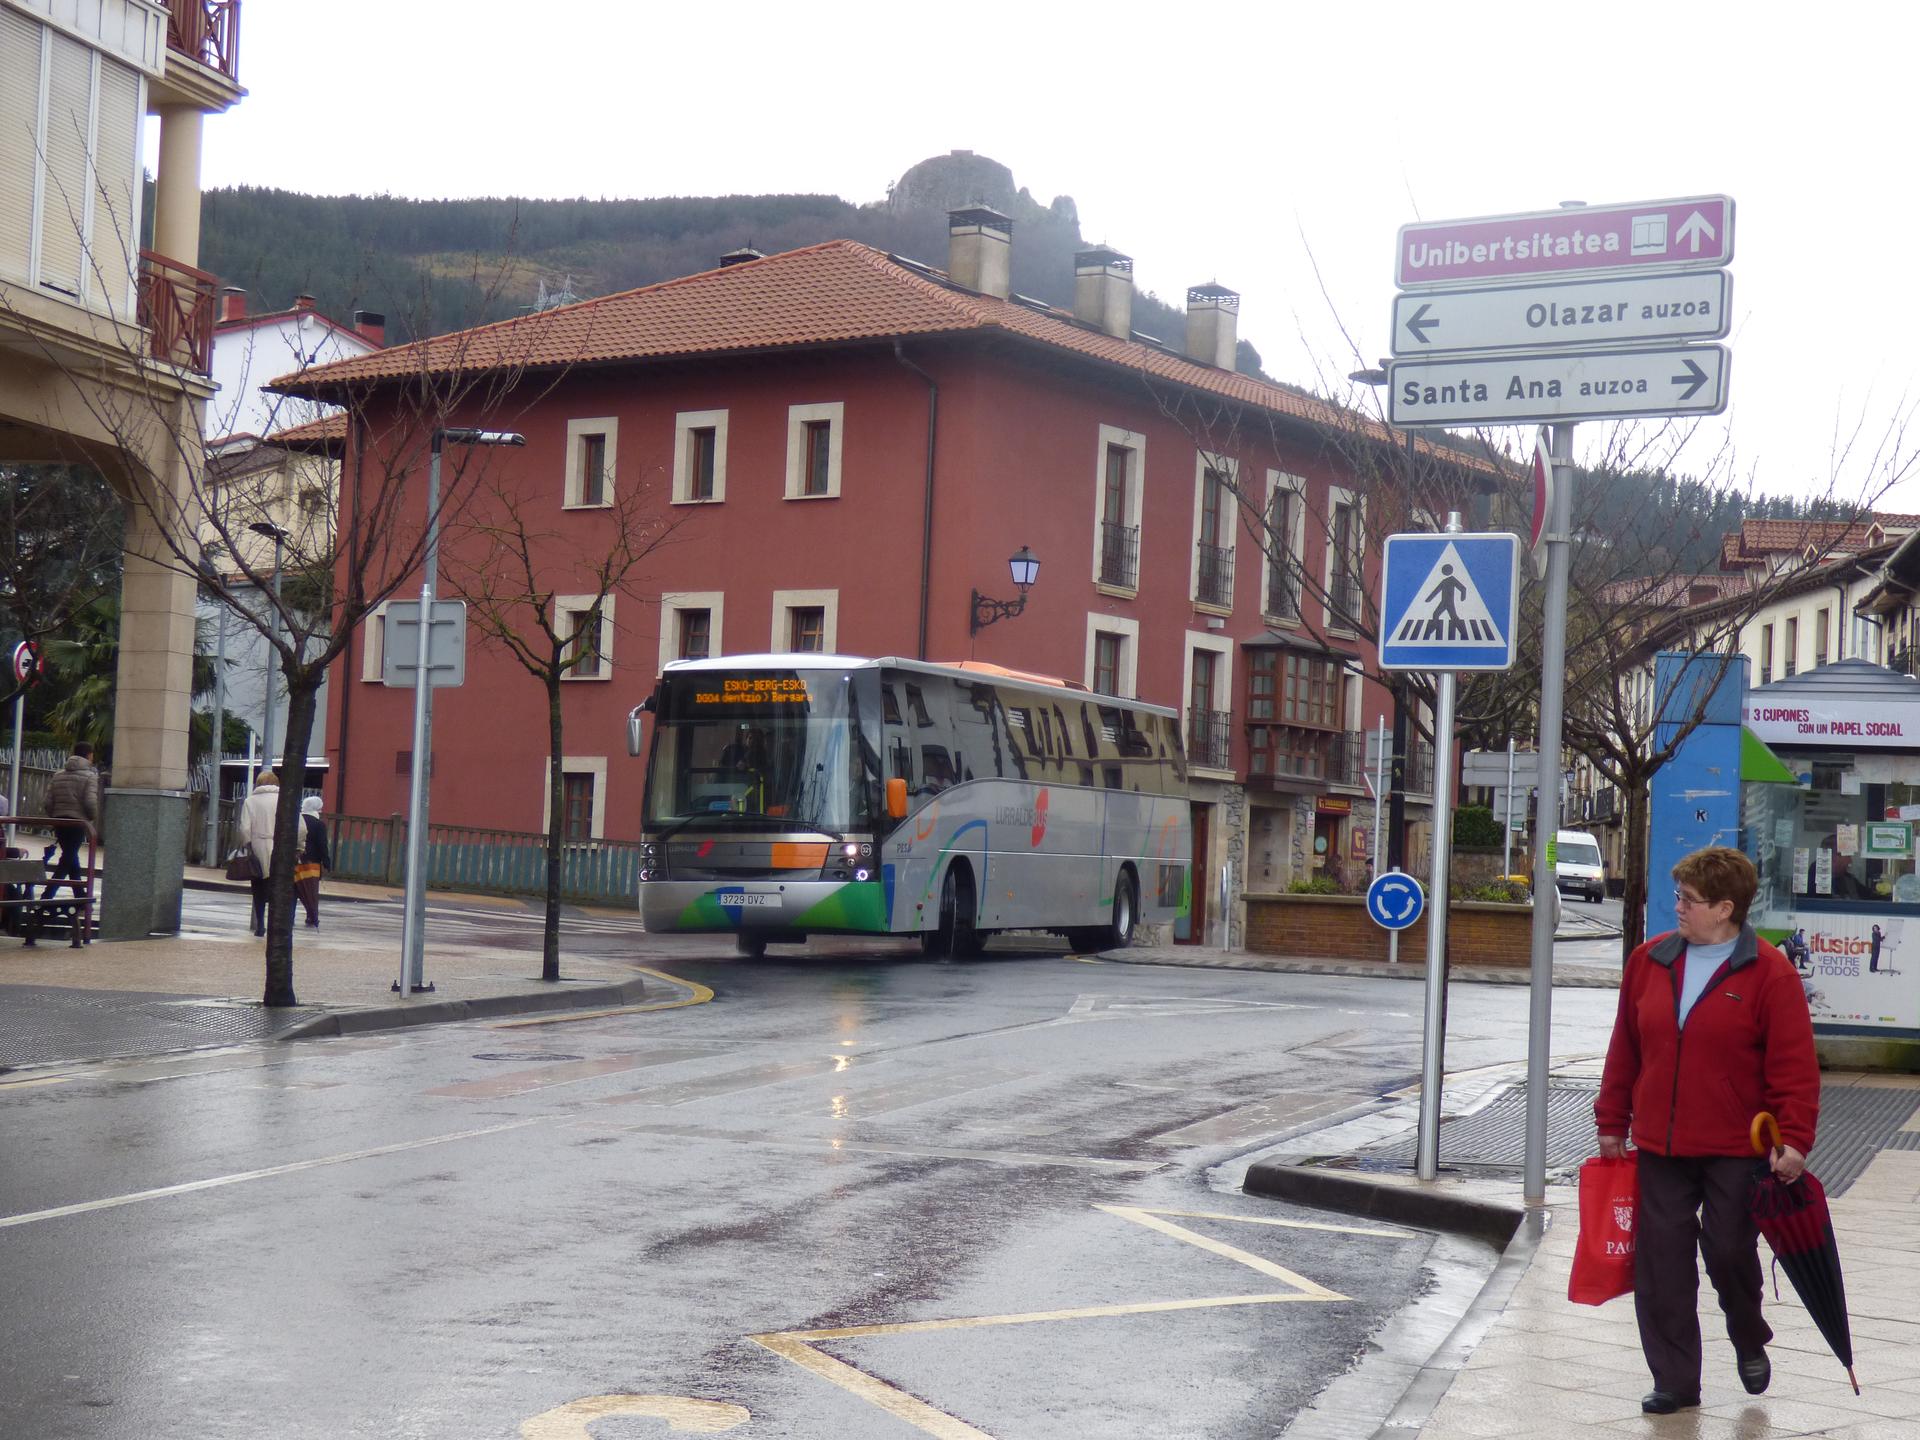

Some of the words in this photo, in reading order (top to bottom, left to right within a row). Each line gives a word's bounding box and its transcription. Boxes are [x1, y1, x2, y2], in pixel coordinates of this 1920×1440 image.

[1408, 229, 1620, 268] Unibertsitatea
[1526, 300, 1629, 328] Olazar
[1641, 300, 1711, 320] auzoa
[1402, 379, 1489, 406] Santa
[1506, 375, 1562, 401] Ana
[1580, 378, 1648, 397] auzoa
[1753, 708, 1761, 721] 3
[1763, 708, 1810, 722] CUPONES
[1798, 723, 1814, 734] CON
[1816, 724, 1828, 735] UN
[1830, 721, 1864, 736] PAPEL
[1865, 722, 1903, 737] SOCIAL
[723, 895, 745, 905] 3729
[747, 895, 765, 905] DVZ
[1810, 932, 1873, 955] ilusión
[1822, 955, 1861, 967] ENTRE
[1818, 965, 1860, 977] TODOS
